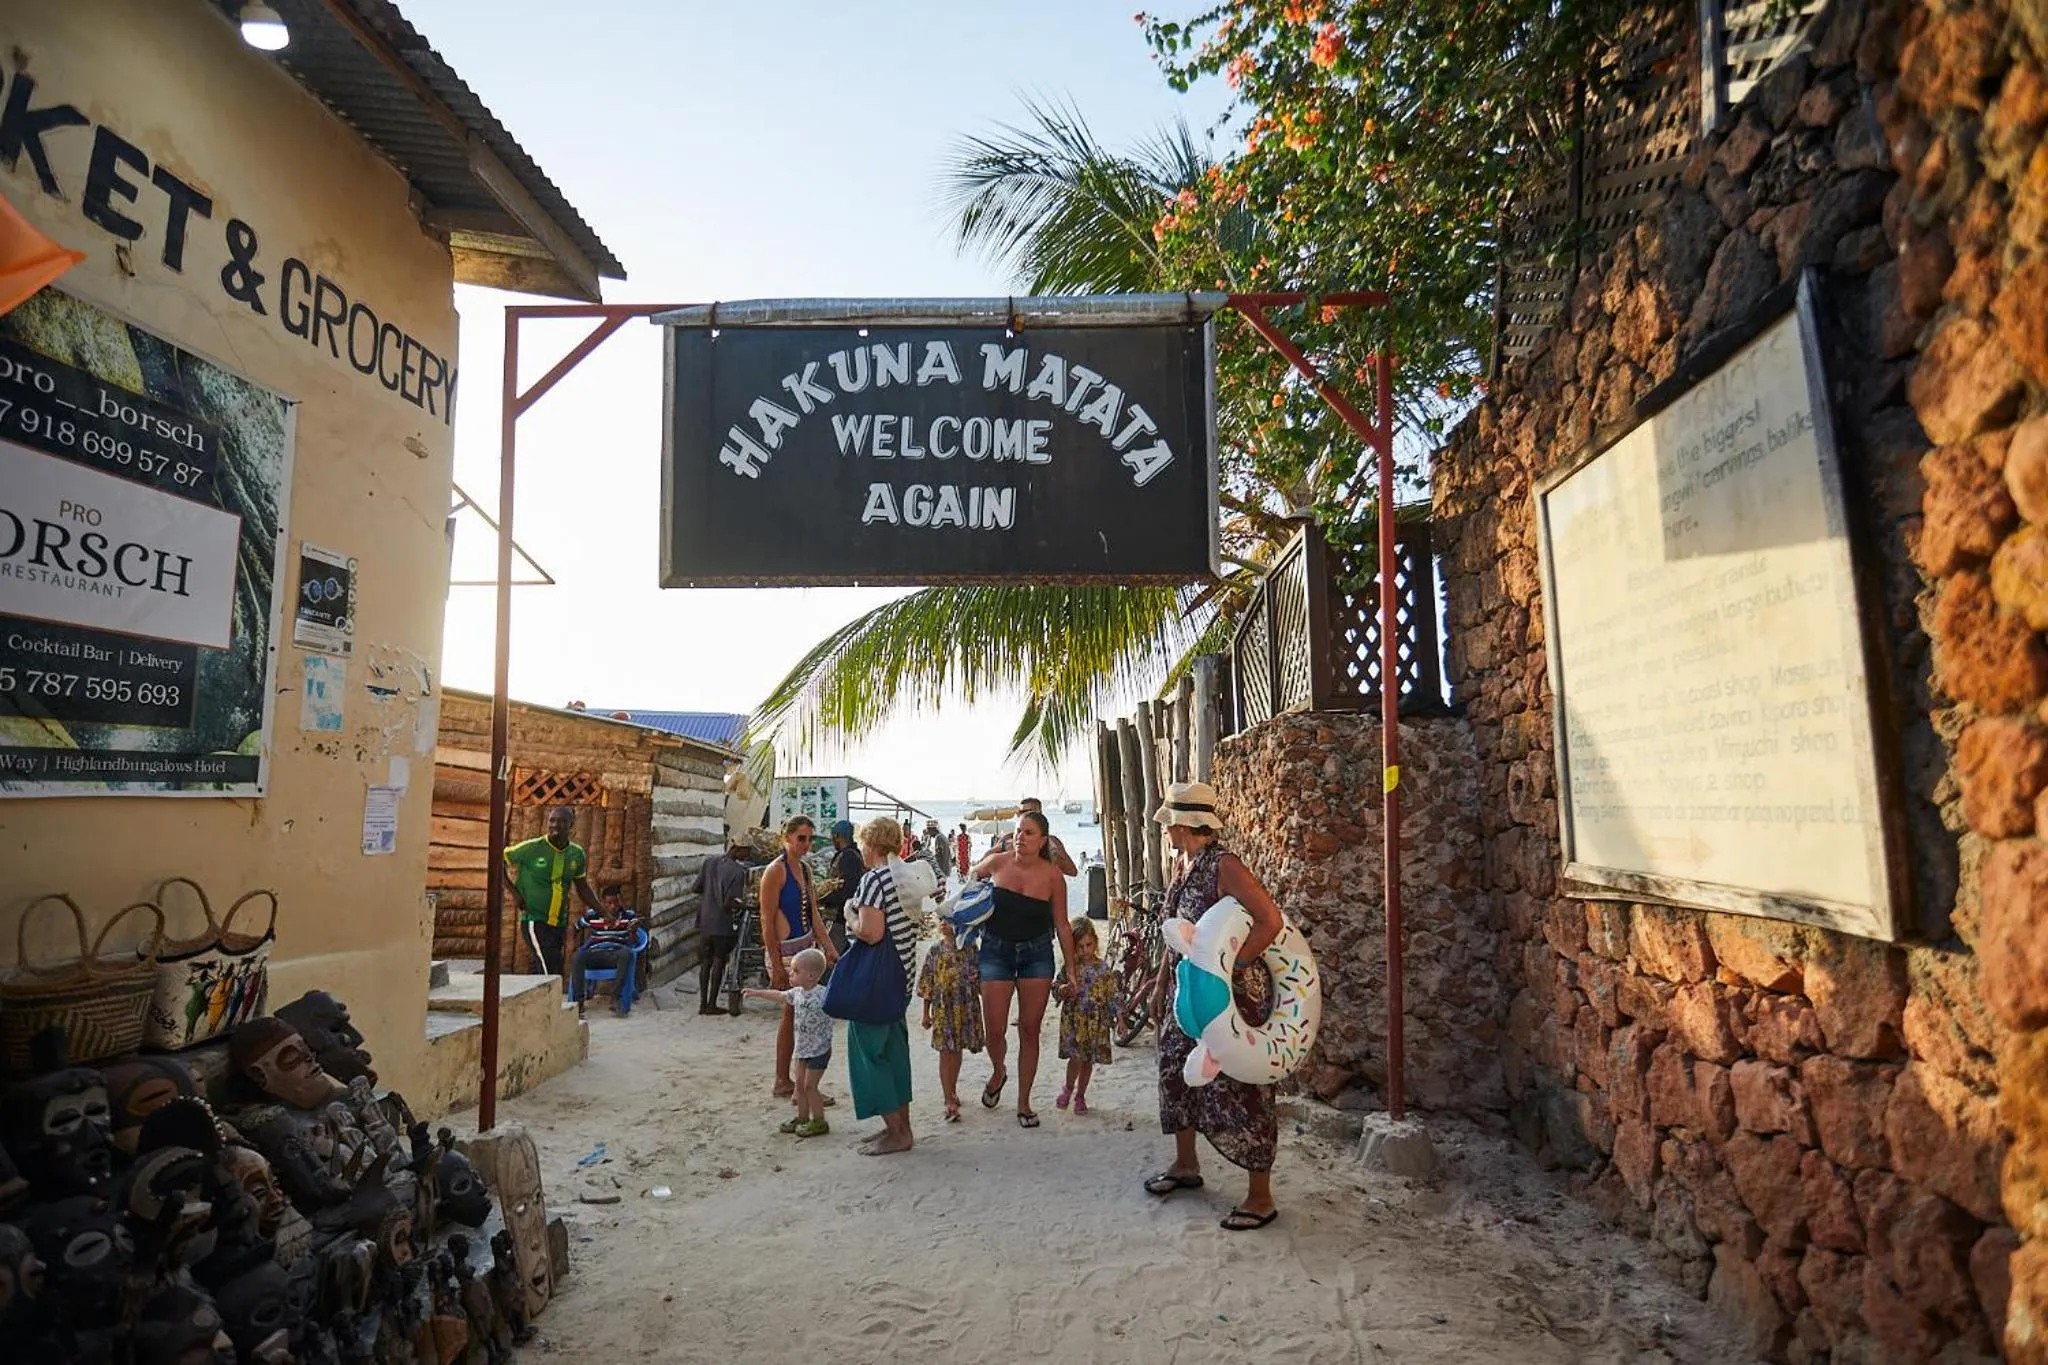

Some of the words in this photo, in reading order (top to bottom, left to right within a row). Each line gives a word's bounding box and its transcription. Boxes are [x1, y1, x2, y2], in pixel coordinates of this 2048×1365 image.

[0, 66, 212, 274] KET
[221, 219, 267, 315] &
[281, 257, 458, 426] GROCERY
[718, 340, 963, 479] HAKUNA
[980, 342, 1175, 486] MATATA
[20, 408, 76, 446] 918
[83, 430, 132, 464] 699
[138, 451, 170, 476] 57
[173, 462, 203, 488] 87
[831, 413, 1053, 464] WELCOME
[60, 500, 102, 526] PRO
[861, 482, 1017, 530] AGAIN
[2, 562, 125, 599] RESTAURANT
[8, 634, 79, 658] Cocktail
[83, 645, 113, 662] Bar
[129, 652, 183, 674] Delivery
[0, 668, 16, 691] 5
[25, 670, 79, 697] 787
[85, 677, 131, 703] 595
[137, 683, 180, 706] 693
[0, 755, 38, 774] Way
[56, 756, 192, 774] Highlandbungalows
[195, 758, 226, 774] Hotel
